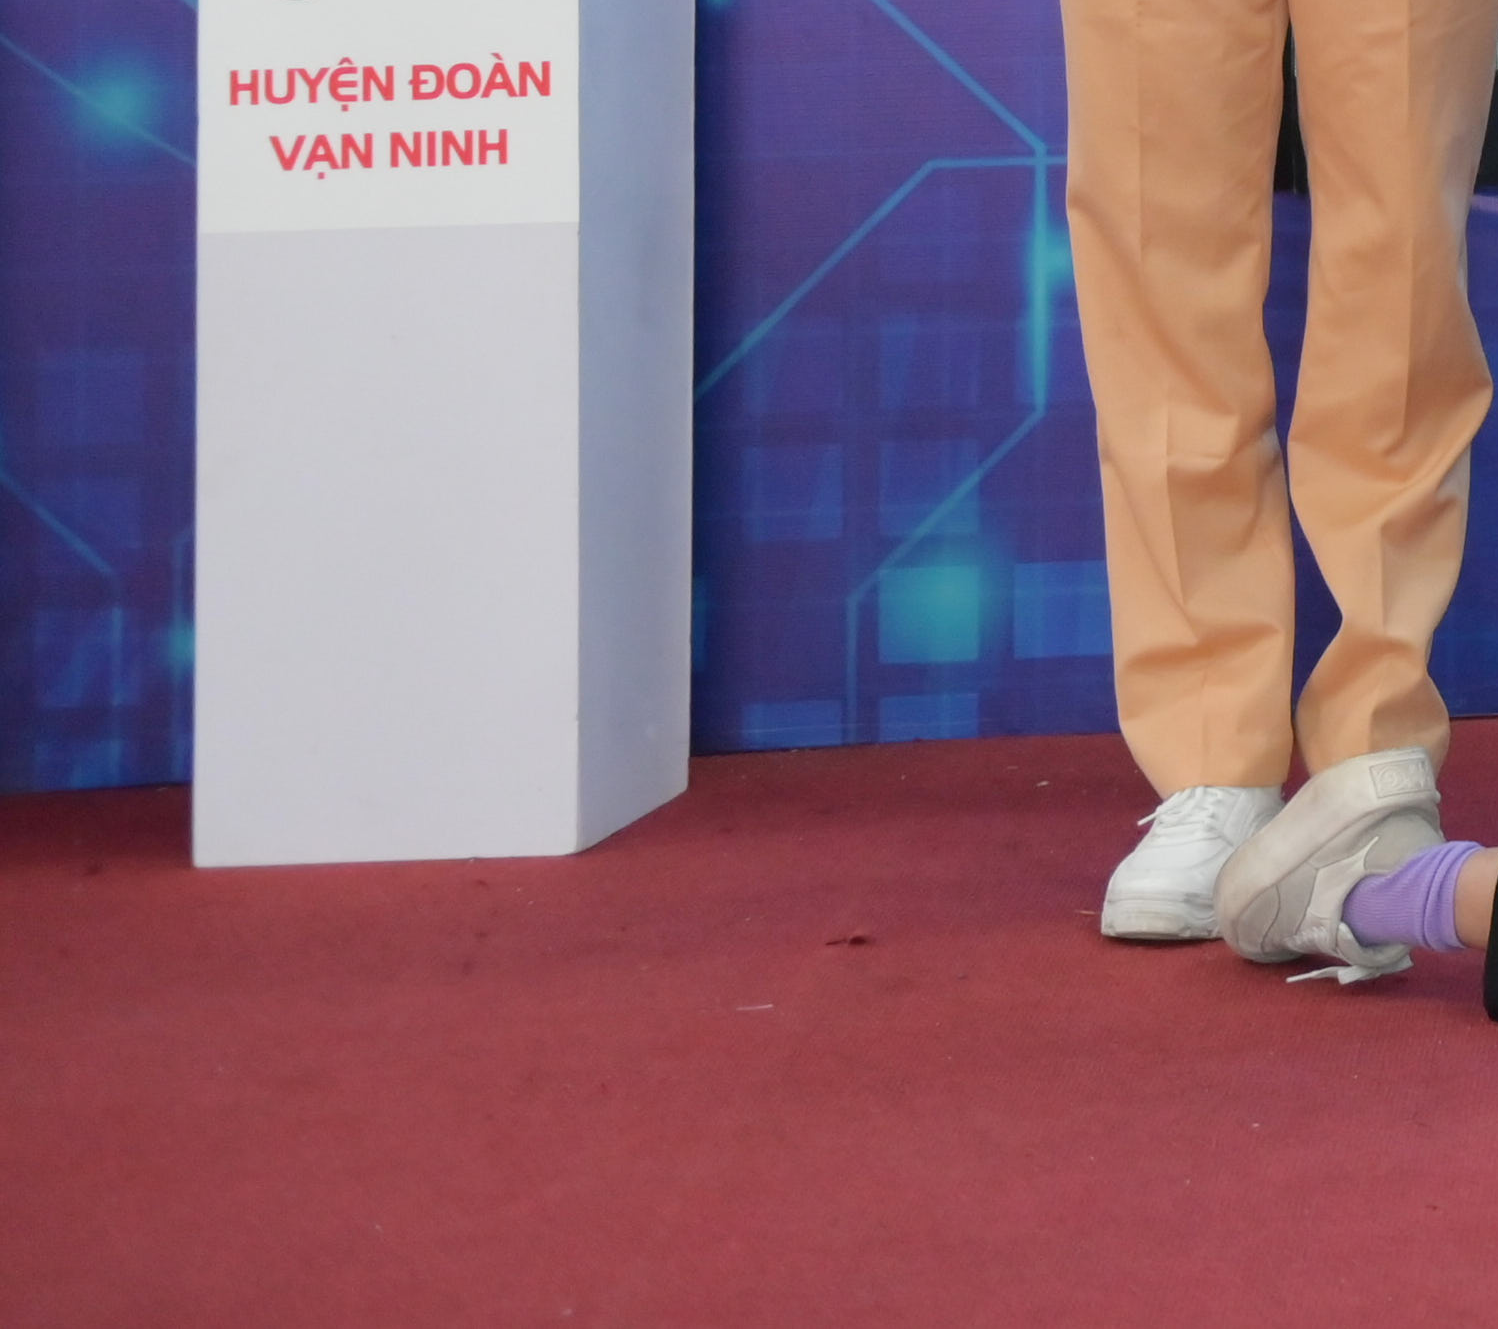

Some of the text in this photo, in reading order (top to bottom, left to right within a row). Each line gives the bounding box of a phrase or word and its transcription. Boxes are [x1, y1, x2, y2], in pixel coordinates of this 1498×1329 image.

[229, 52, 552, 112] HUYỆN ĐOÀN
[269, 128, 509, 180] VẠN NINH
